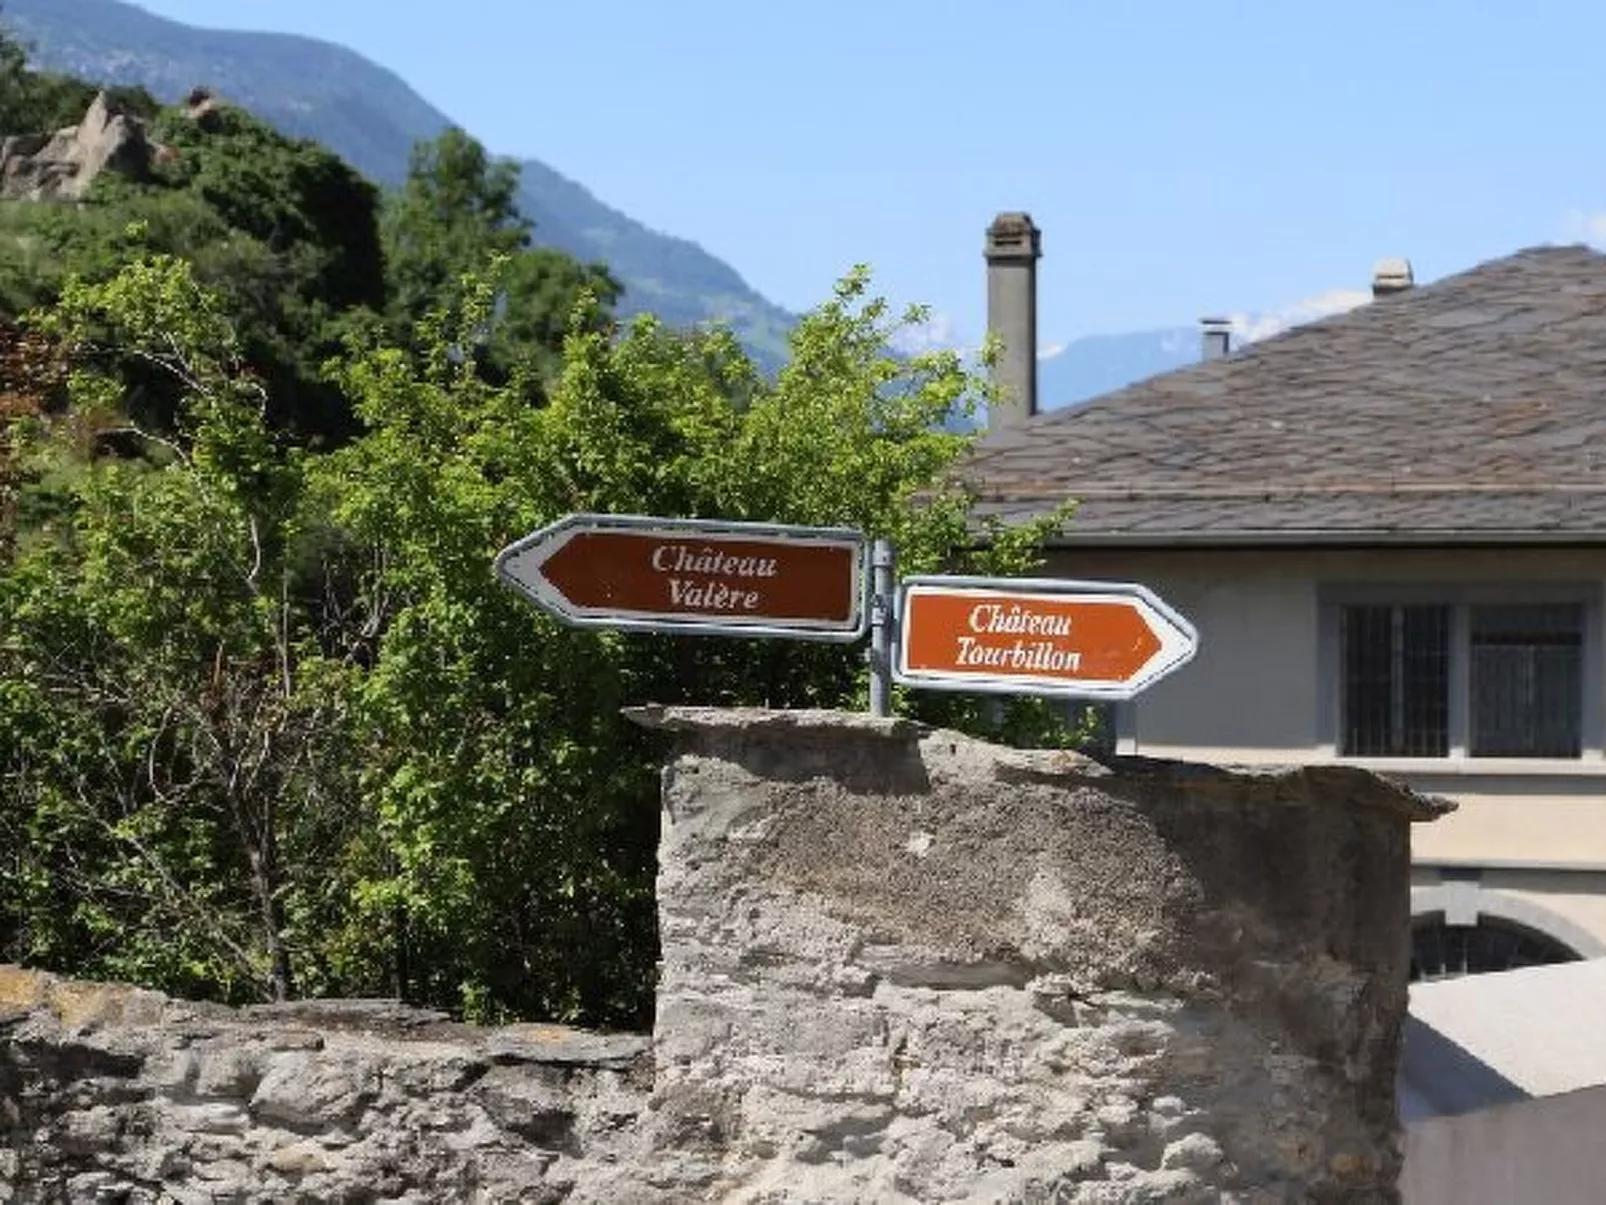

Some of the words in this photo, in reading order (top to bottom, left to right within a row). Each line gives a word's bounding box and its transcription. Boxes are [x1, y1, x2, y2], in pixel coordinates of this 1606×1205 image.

[651, 545, 778, 577] Château
[668, 578, 759, 609] Valère
[968, 604, 1073, 636] Château
[955, 636, 1082, 673] Tourbillon
